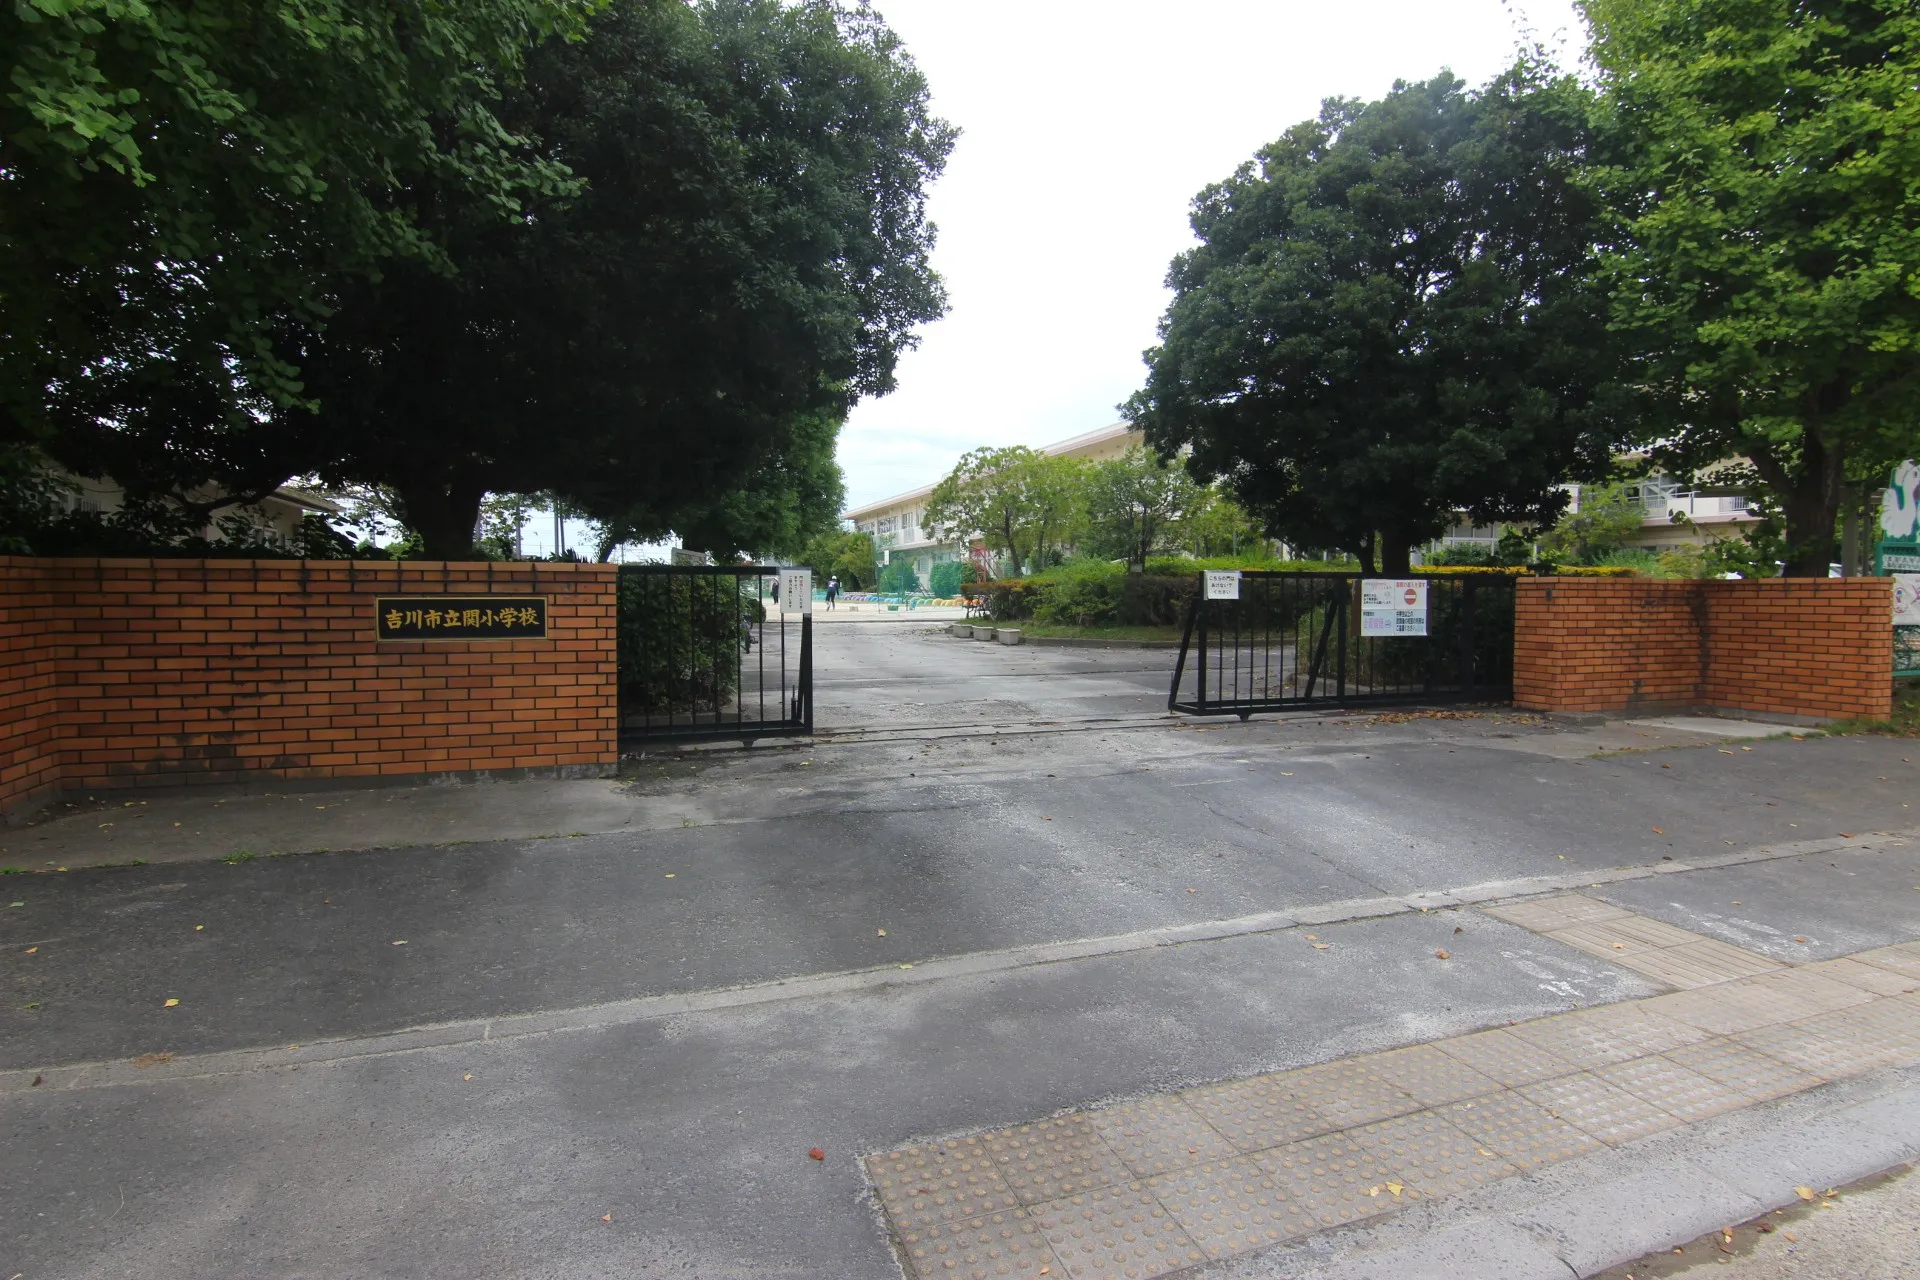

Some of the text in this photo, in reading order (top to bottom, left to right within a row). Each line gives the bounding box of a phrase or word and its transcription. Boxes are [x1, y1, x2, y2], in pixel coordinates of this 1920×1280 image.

[385, 607, 540, 630] 吉川市立関小学校
